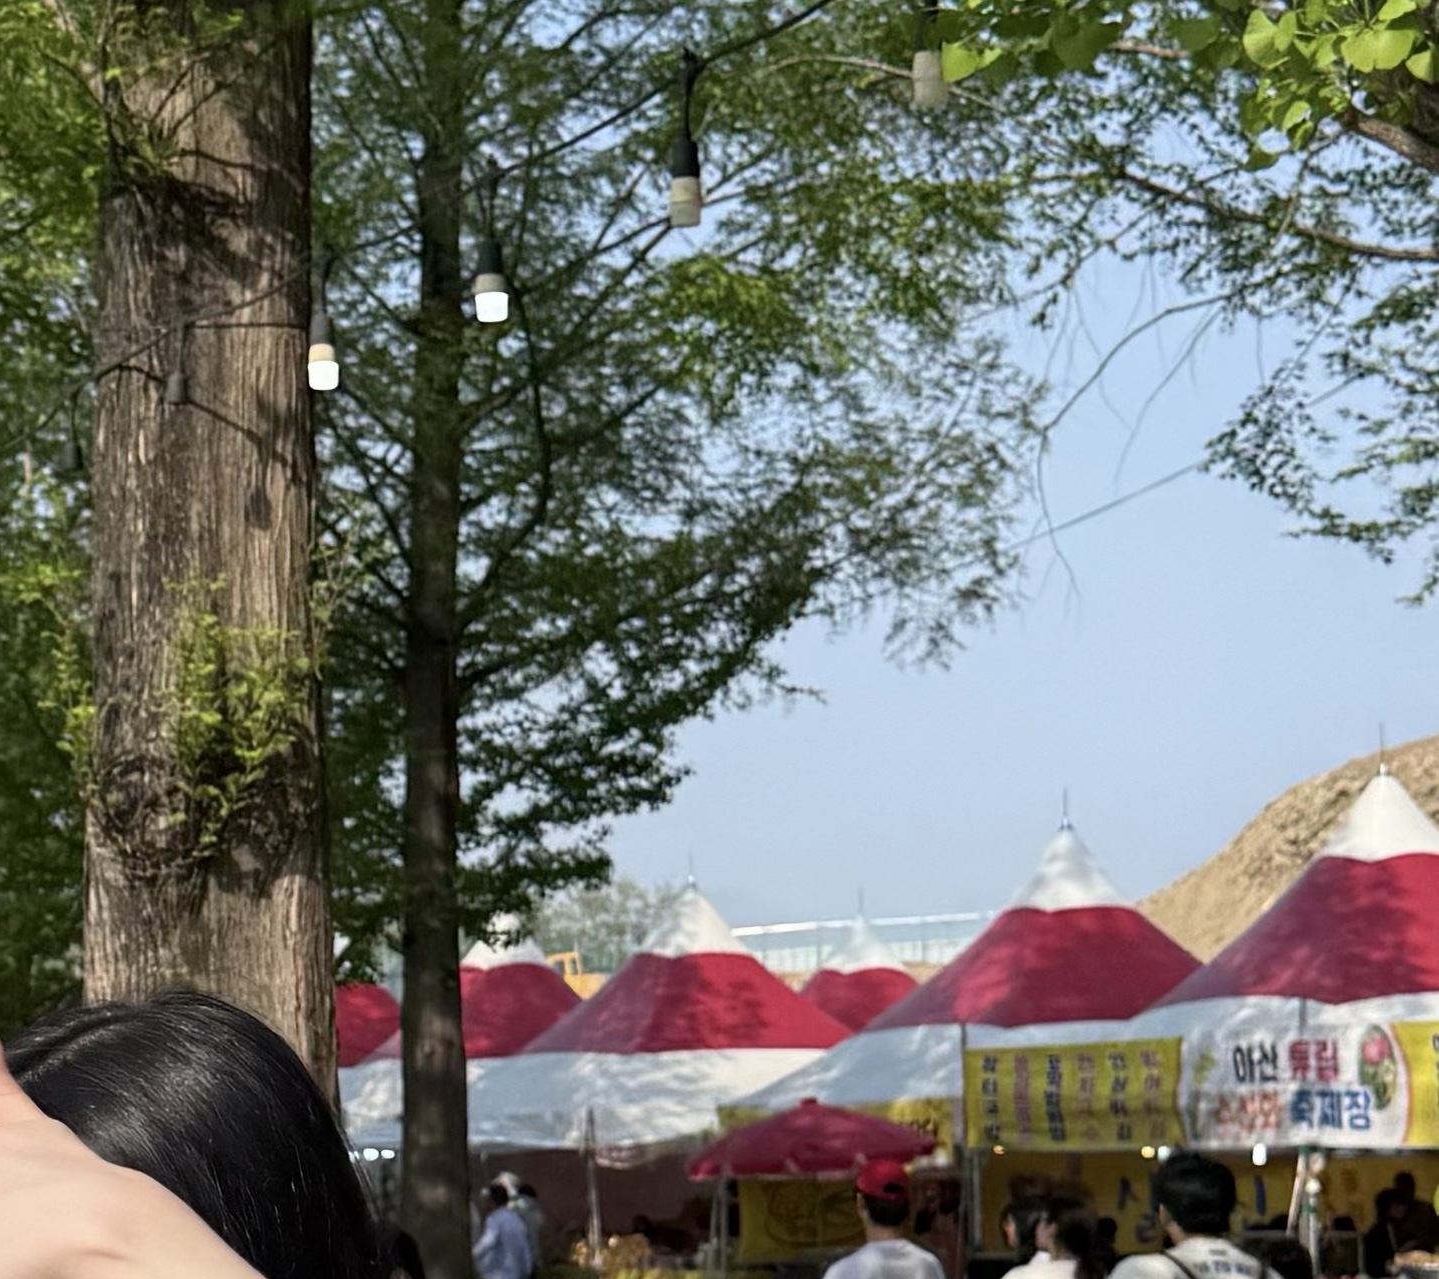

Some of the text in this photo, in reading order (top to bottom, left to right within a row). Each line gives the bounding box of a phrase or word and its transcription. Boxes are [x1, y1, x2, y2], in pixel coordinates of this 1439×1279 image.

[1233, 1038, 1339, 1082] 아산 튤립
[1290, 1087, 1372, 1131] 축제장
